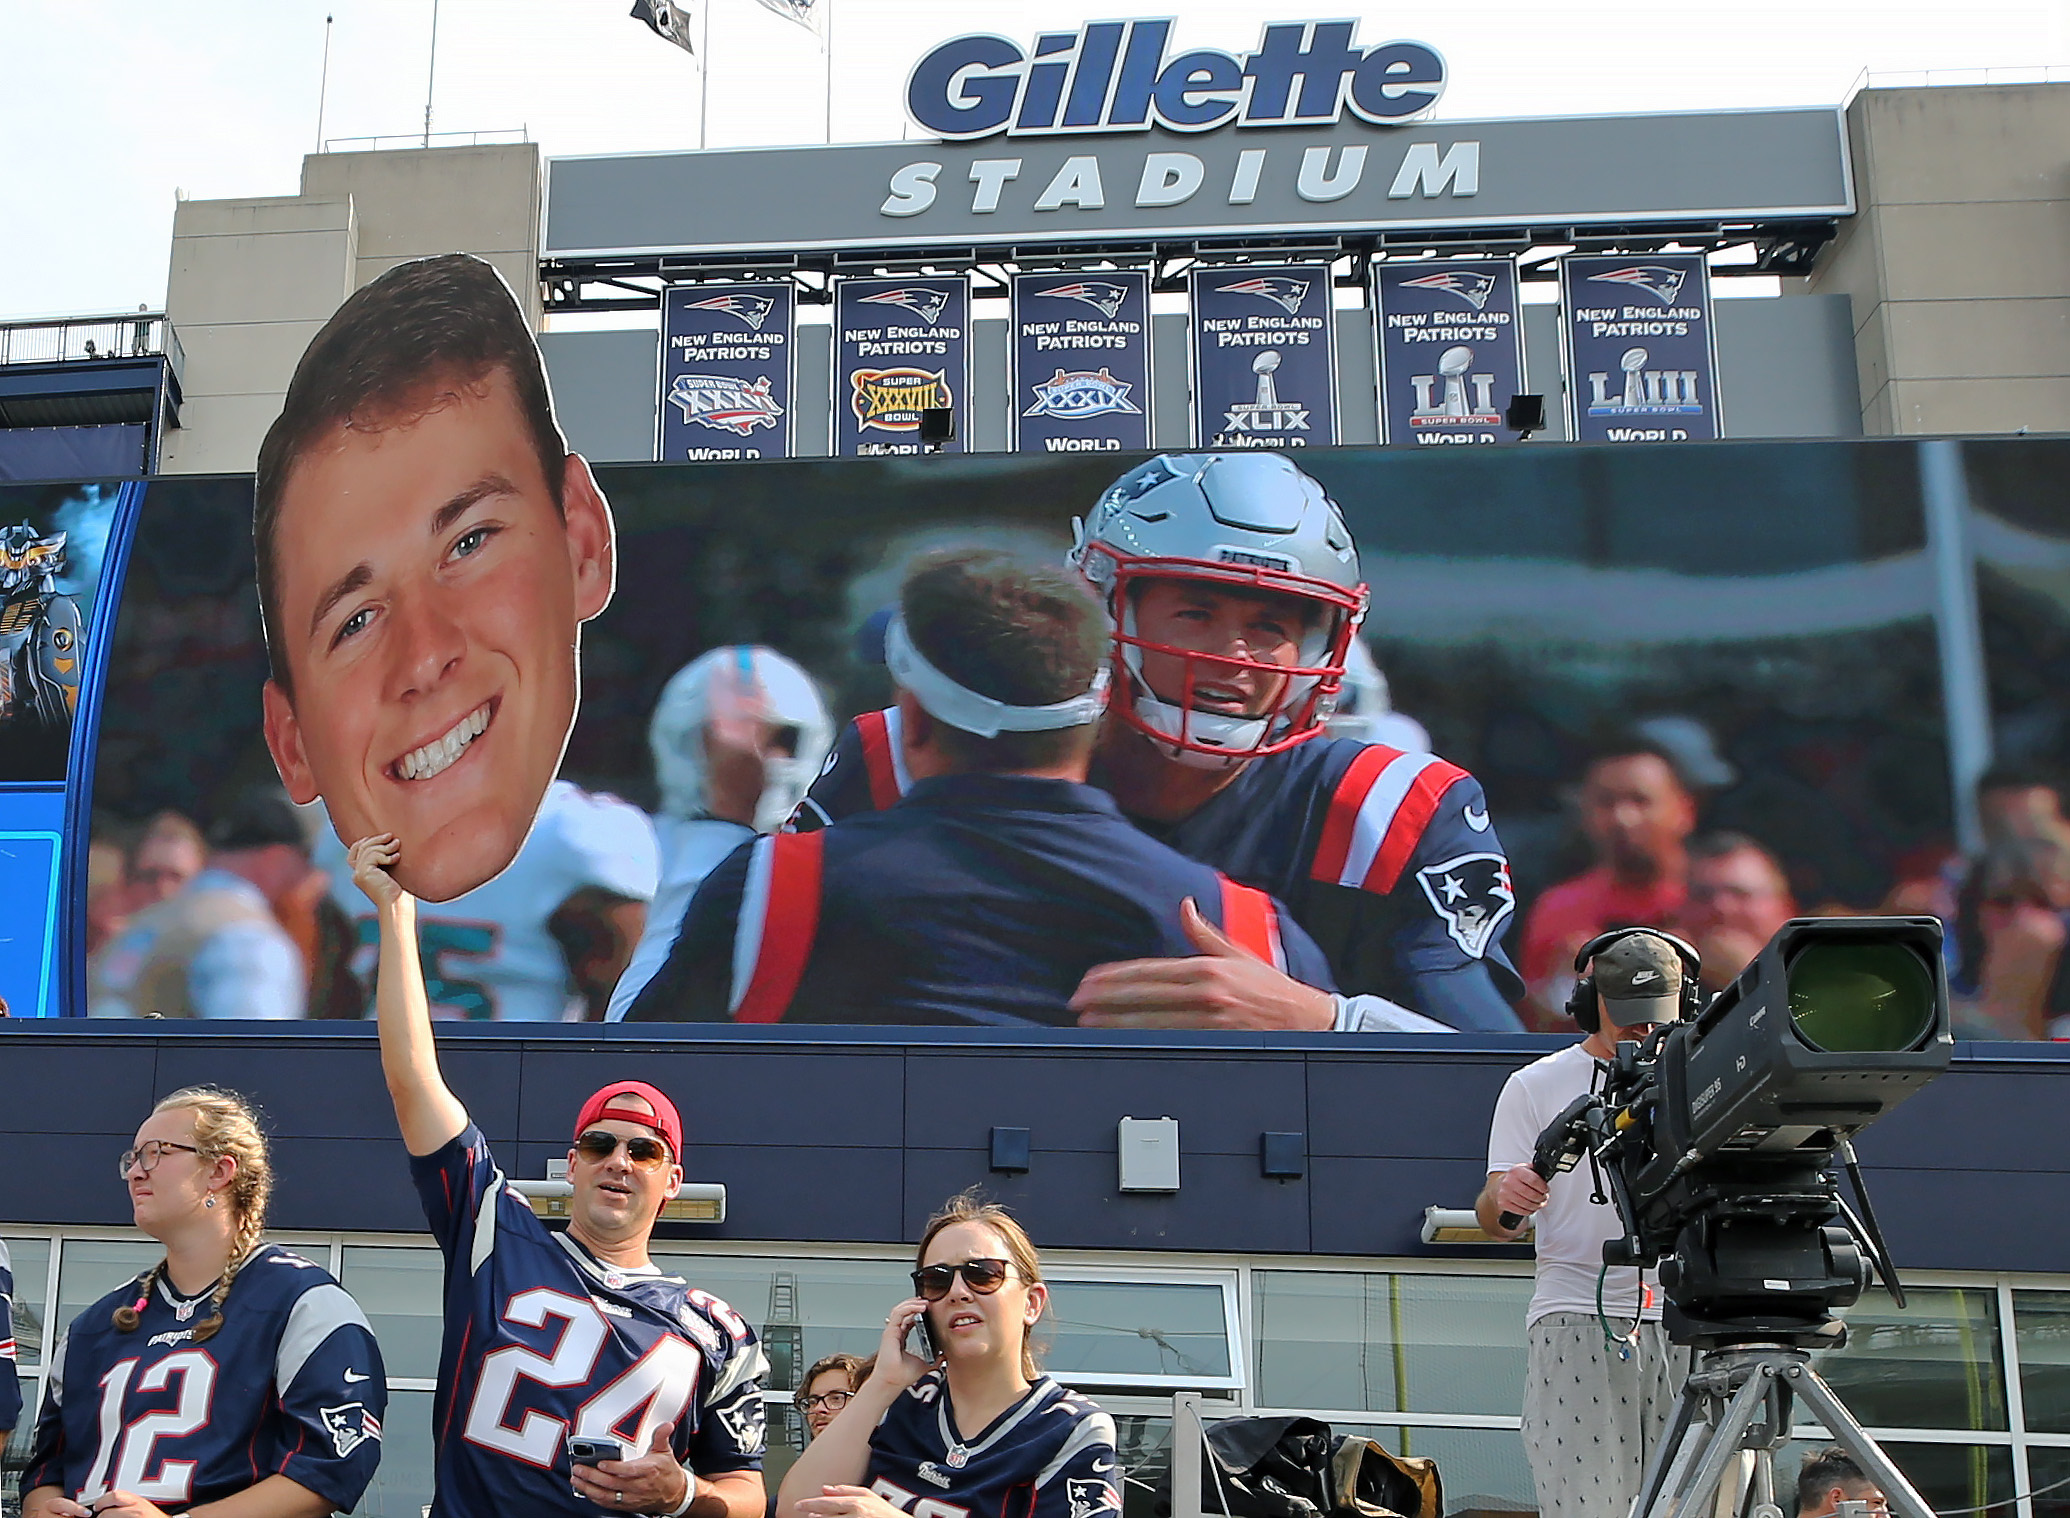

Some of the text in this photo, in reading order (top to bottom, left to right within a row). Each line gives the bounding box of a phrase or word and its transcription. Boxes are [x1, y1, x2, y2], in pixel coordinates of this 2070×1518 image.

[905, 17, 1446, 140] Gillette
[881, 142, 1480, 217] STADIUM
[1388, 311, 1510, 328] NEW ENGLAND
[1576, 305, 1702, 322] NEW ENGLAND
[1022, 320, 1140, 336] NEW ENGLAND
[1203, 316, 1323, 332] NEW ENGLAND
[1592, 321, 1689, 338] PATRIOTS
[671, 332, 784, 348] NEW ENGLAND
[845, 326, 961, 342] NEW ENGLAND
[1218, 331, 1311, 348] PATRIOTS
[1404, 327, 1498, 343] PATRIOTS
[858, 341, 947, 357] PATRIOTS
[1037, 335, 1127, 351] PATRIOTS
[684, 346, 771, 363] PATRIOTS
[882, 377, 922, 386] SUPER
[1588, 370, 1700, 406] LIII
[1032, 387, 1134, 411] XXXIX
[1410, 373, 1496, 416] LI
[885, 413, 920, 422] BOWL
[1610, 406, 1648, 414] SUPER
[1223, 410, 1312, 432] XLIX
[1421, 416, 1491, 426] SUPER BOWL
[1045, 437, 1122, 451] WORLD
[1735, 1055, 1747, 1073] HD
[76, 1348, 219, 1505] 12
